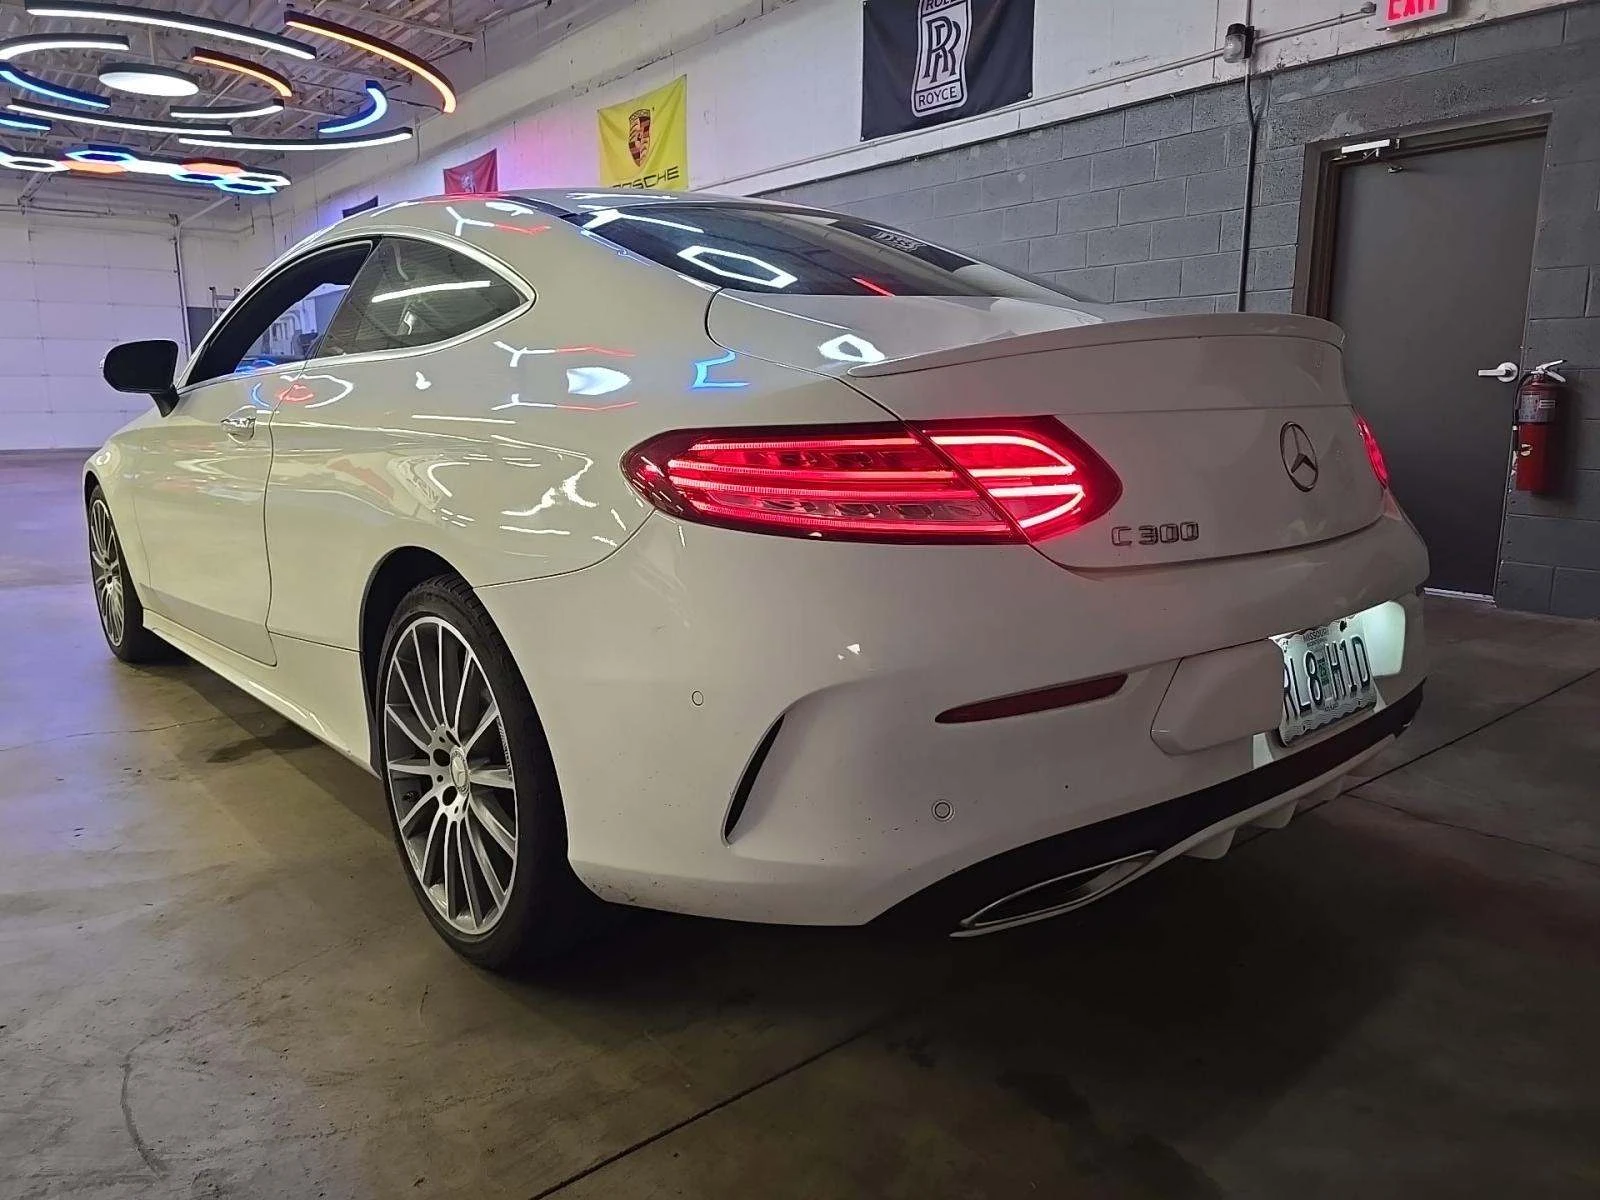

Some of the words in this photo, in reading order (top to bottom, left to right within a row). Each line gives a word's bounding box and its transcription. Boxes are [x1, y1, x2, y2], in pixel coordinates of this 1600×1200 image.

[918, 86, 957, 107] ROYCE
[609, 166, 680, 190] SCHE
[1111, 526, 1132, 546] C
[1138, 521, 1199, 545] 300
